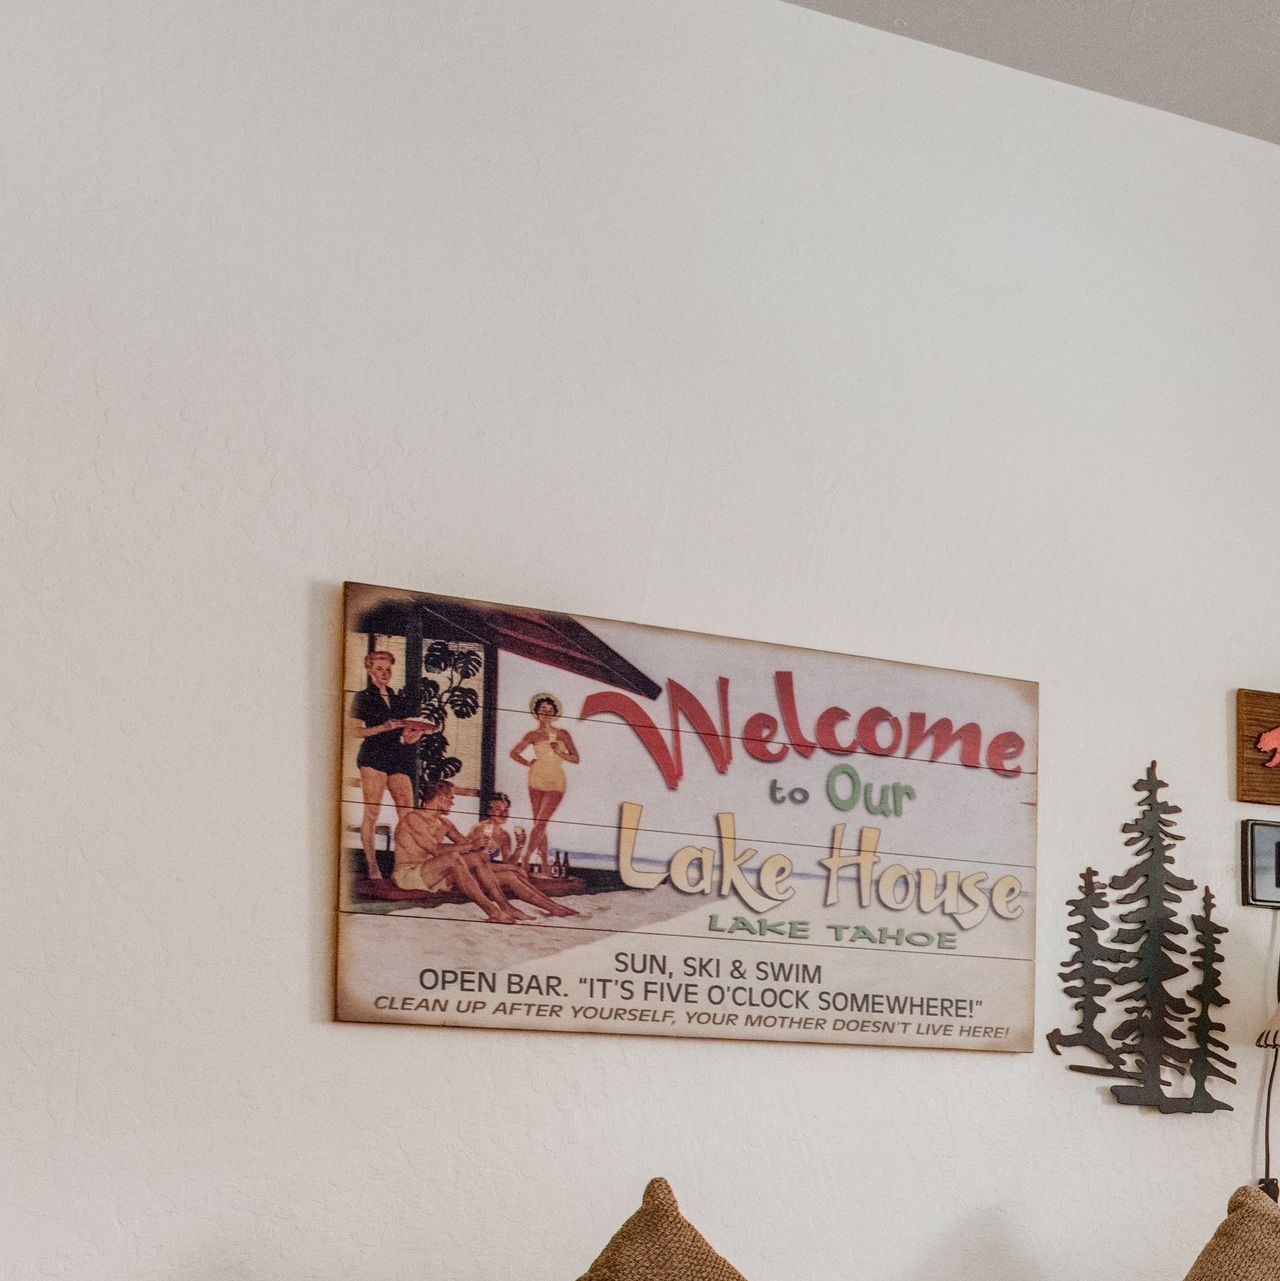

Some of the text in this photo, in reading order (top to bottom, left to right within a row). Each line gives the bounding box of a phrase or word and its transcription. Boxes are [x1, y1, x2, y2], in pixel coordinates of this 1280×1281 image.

[580, 671, 1025, 790] Welcome
[769, 763, 916, 816] to Our
[617, 801, 1024, 931] Lake House
[707, 914, 958, 950] LAKE TAHOE
[419, 968, 496, 993] OPEN
[507, 974, 569, 997] BAR.
[644, 980, 698, 1004] FIVE
[708, 984, 810, 1010] O'CLOCK
[614, 952, 822, 984] SUN, SKI & SWIM
[374, 996, 1009, 1039] CLEAN UP AFTER YOURSELF, YOUR MOTHER DOESN'T LIVE HERE!
